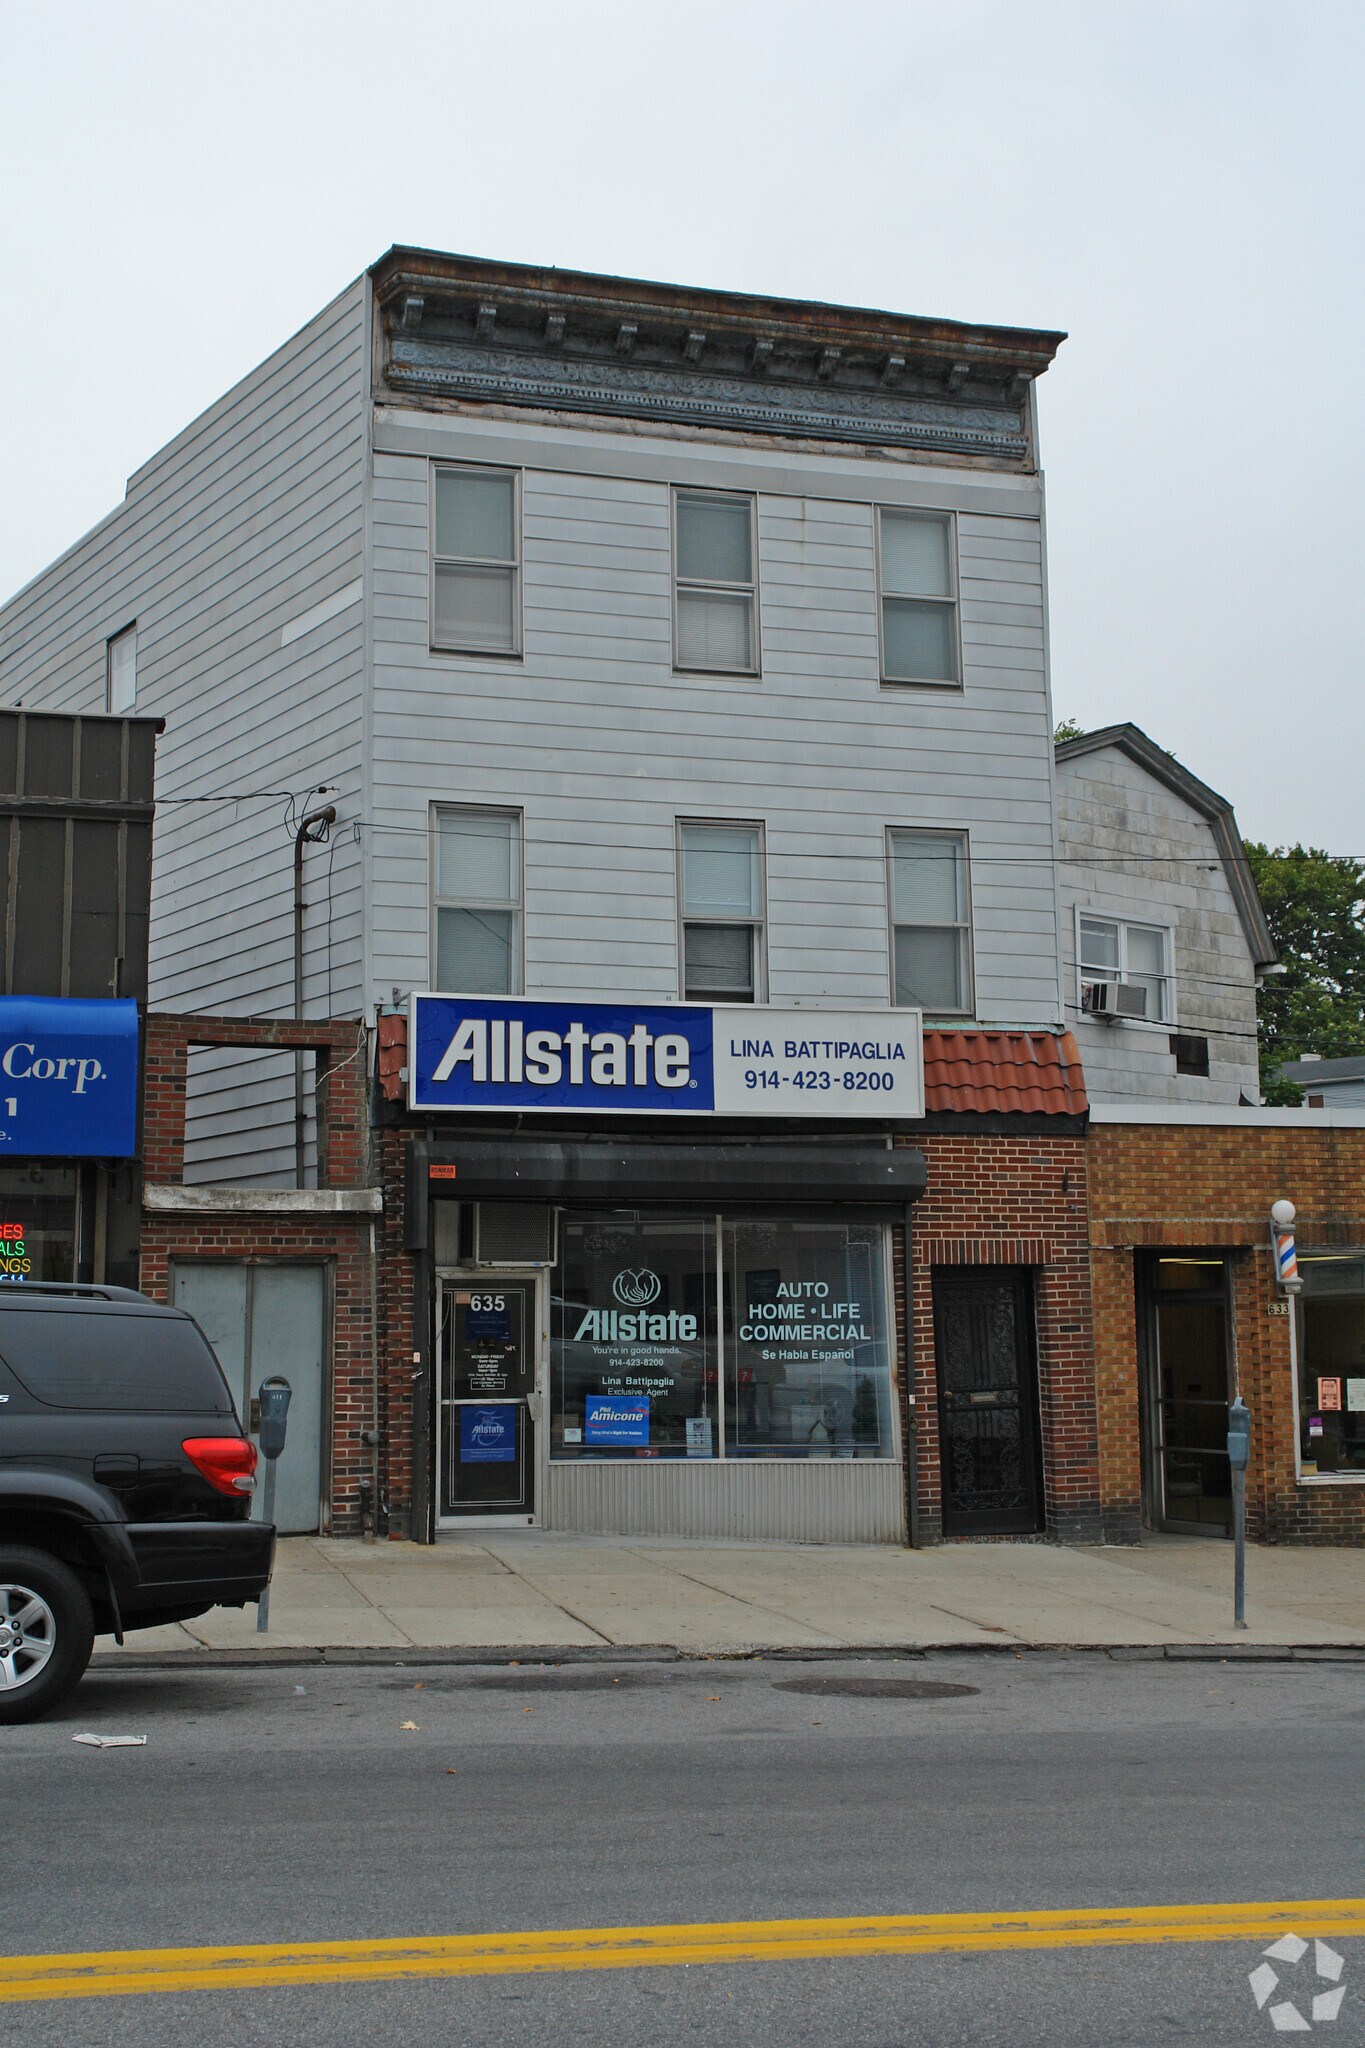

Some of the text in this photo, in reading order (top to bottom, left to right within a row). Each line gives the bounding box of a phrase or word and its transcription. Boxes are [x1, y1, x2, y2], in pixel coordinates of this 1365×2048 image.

[431, 1019, 691, 1088] Allstate
[730, 1040, 906, 1060] LINA BATTIPAGLIA
[2, 1043, 107, 1094] Corp.
[744, 1070, 894, 1091] 914-423-8200
[776, 1282, 829, 1298] AUTO
[470, 1295, 506, 1312] 635
[749, 1303, 861, 1319] HOME LIFE
[1268, 1304, 1289, 1314] 633
[573, 1310, 698, 1341] Allstate
[739, 1324, 871, 1341] COMMERCIAL
[592, 1346, 682, 1356] You're in good hands.
[762, 1348, 854, 1361] Se Habla Español
[609, 1359, 664, 1367] 914-423-8200
[602, 1376, 675, 1387] Lina Battipaglia
[607, 1388, 669, 1397] Exclusive Agent
[590, 1411, 643, 1421] Amicone
[471, 1425, 505, 1434] Allstate
